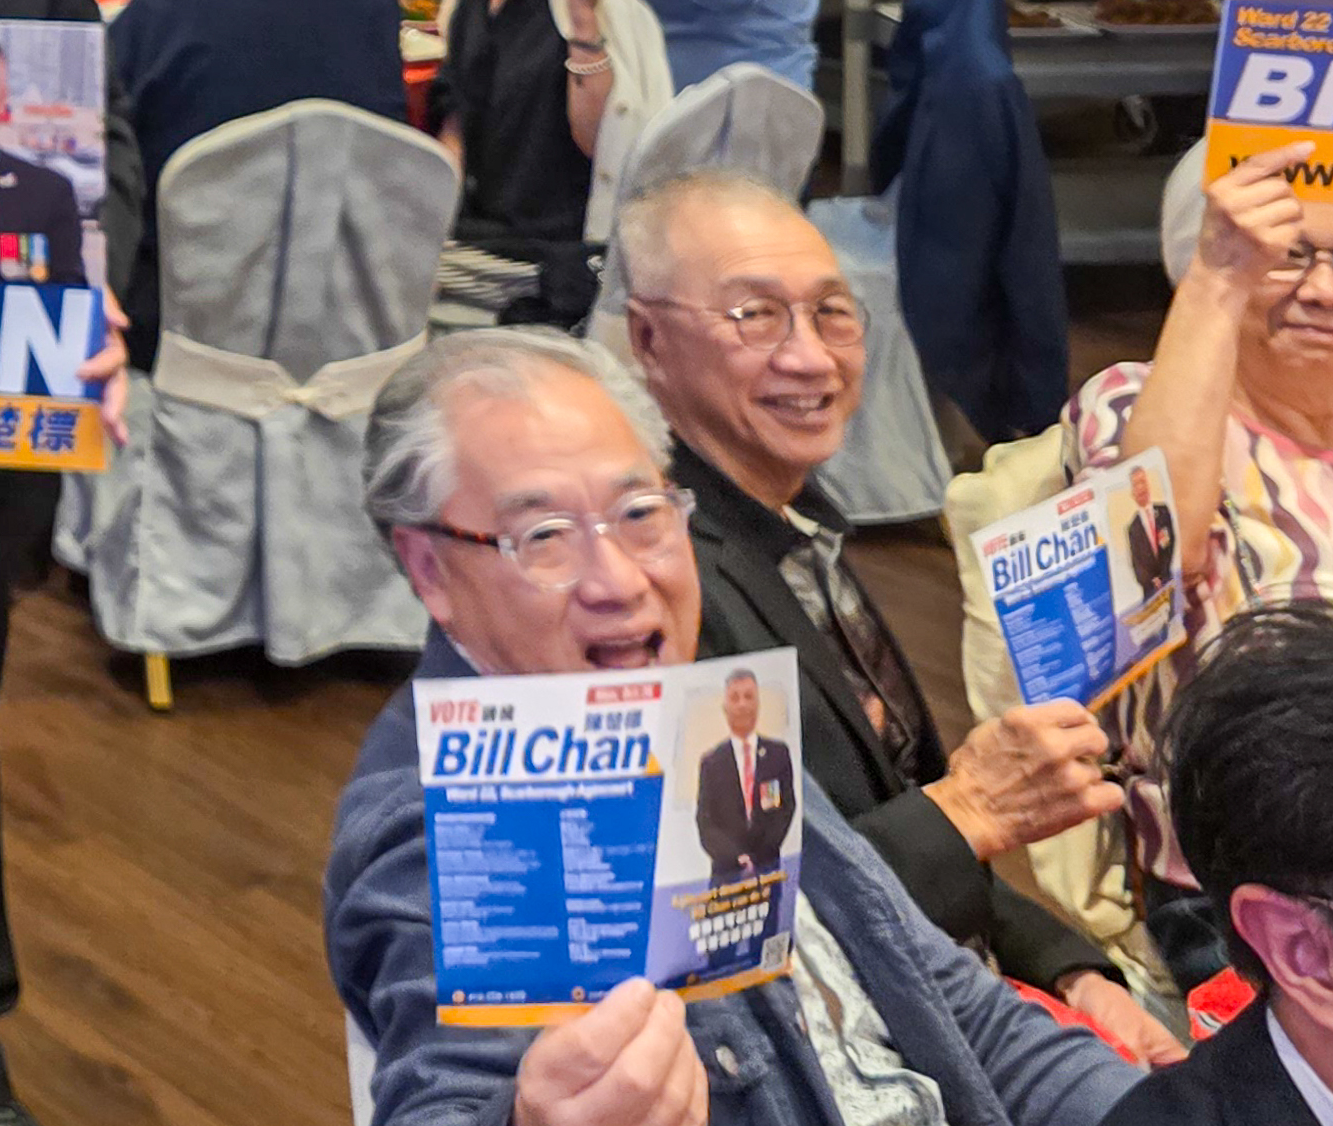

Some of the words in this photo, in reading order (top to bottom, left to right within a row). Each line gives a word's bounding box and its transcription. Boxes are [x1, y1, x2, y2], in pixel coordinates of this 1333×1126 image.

[1237, 6, 1299, 30] Ward
[1300, 11, 1332, 33] 22
[991, 540, 1033, 592] Bill
[1035, 524, 1098, 571] Chan
[430, 700, 479, 724] VOTE
[433, 728, 517, 777] Bill
[523, 725, 651, 774] Chan
